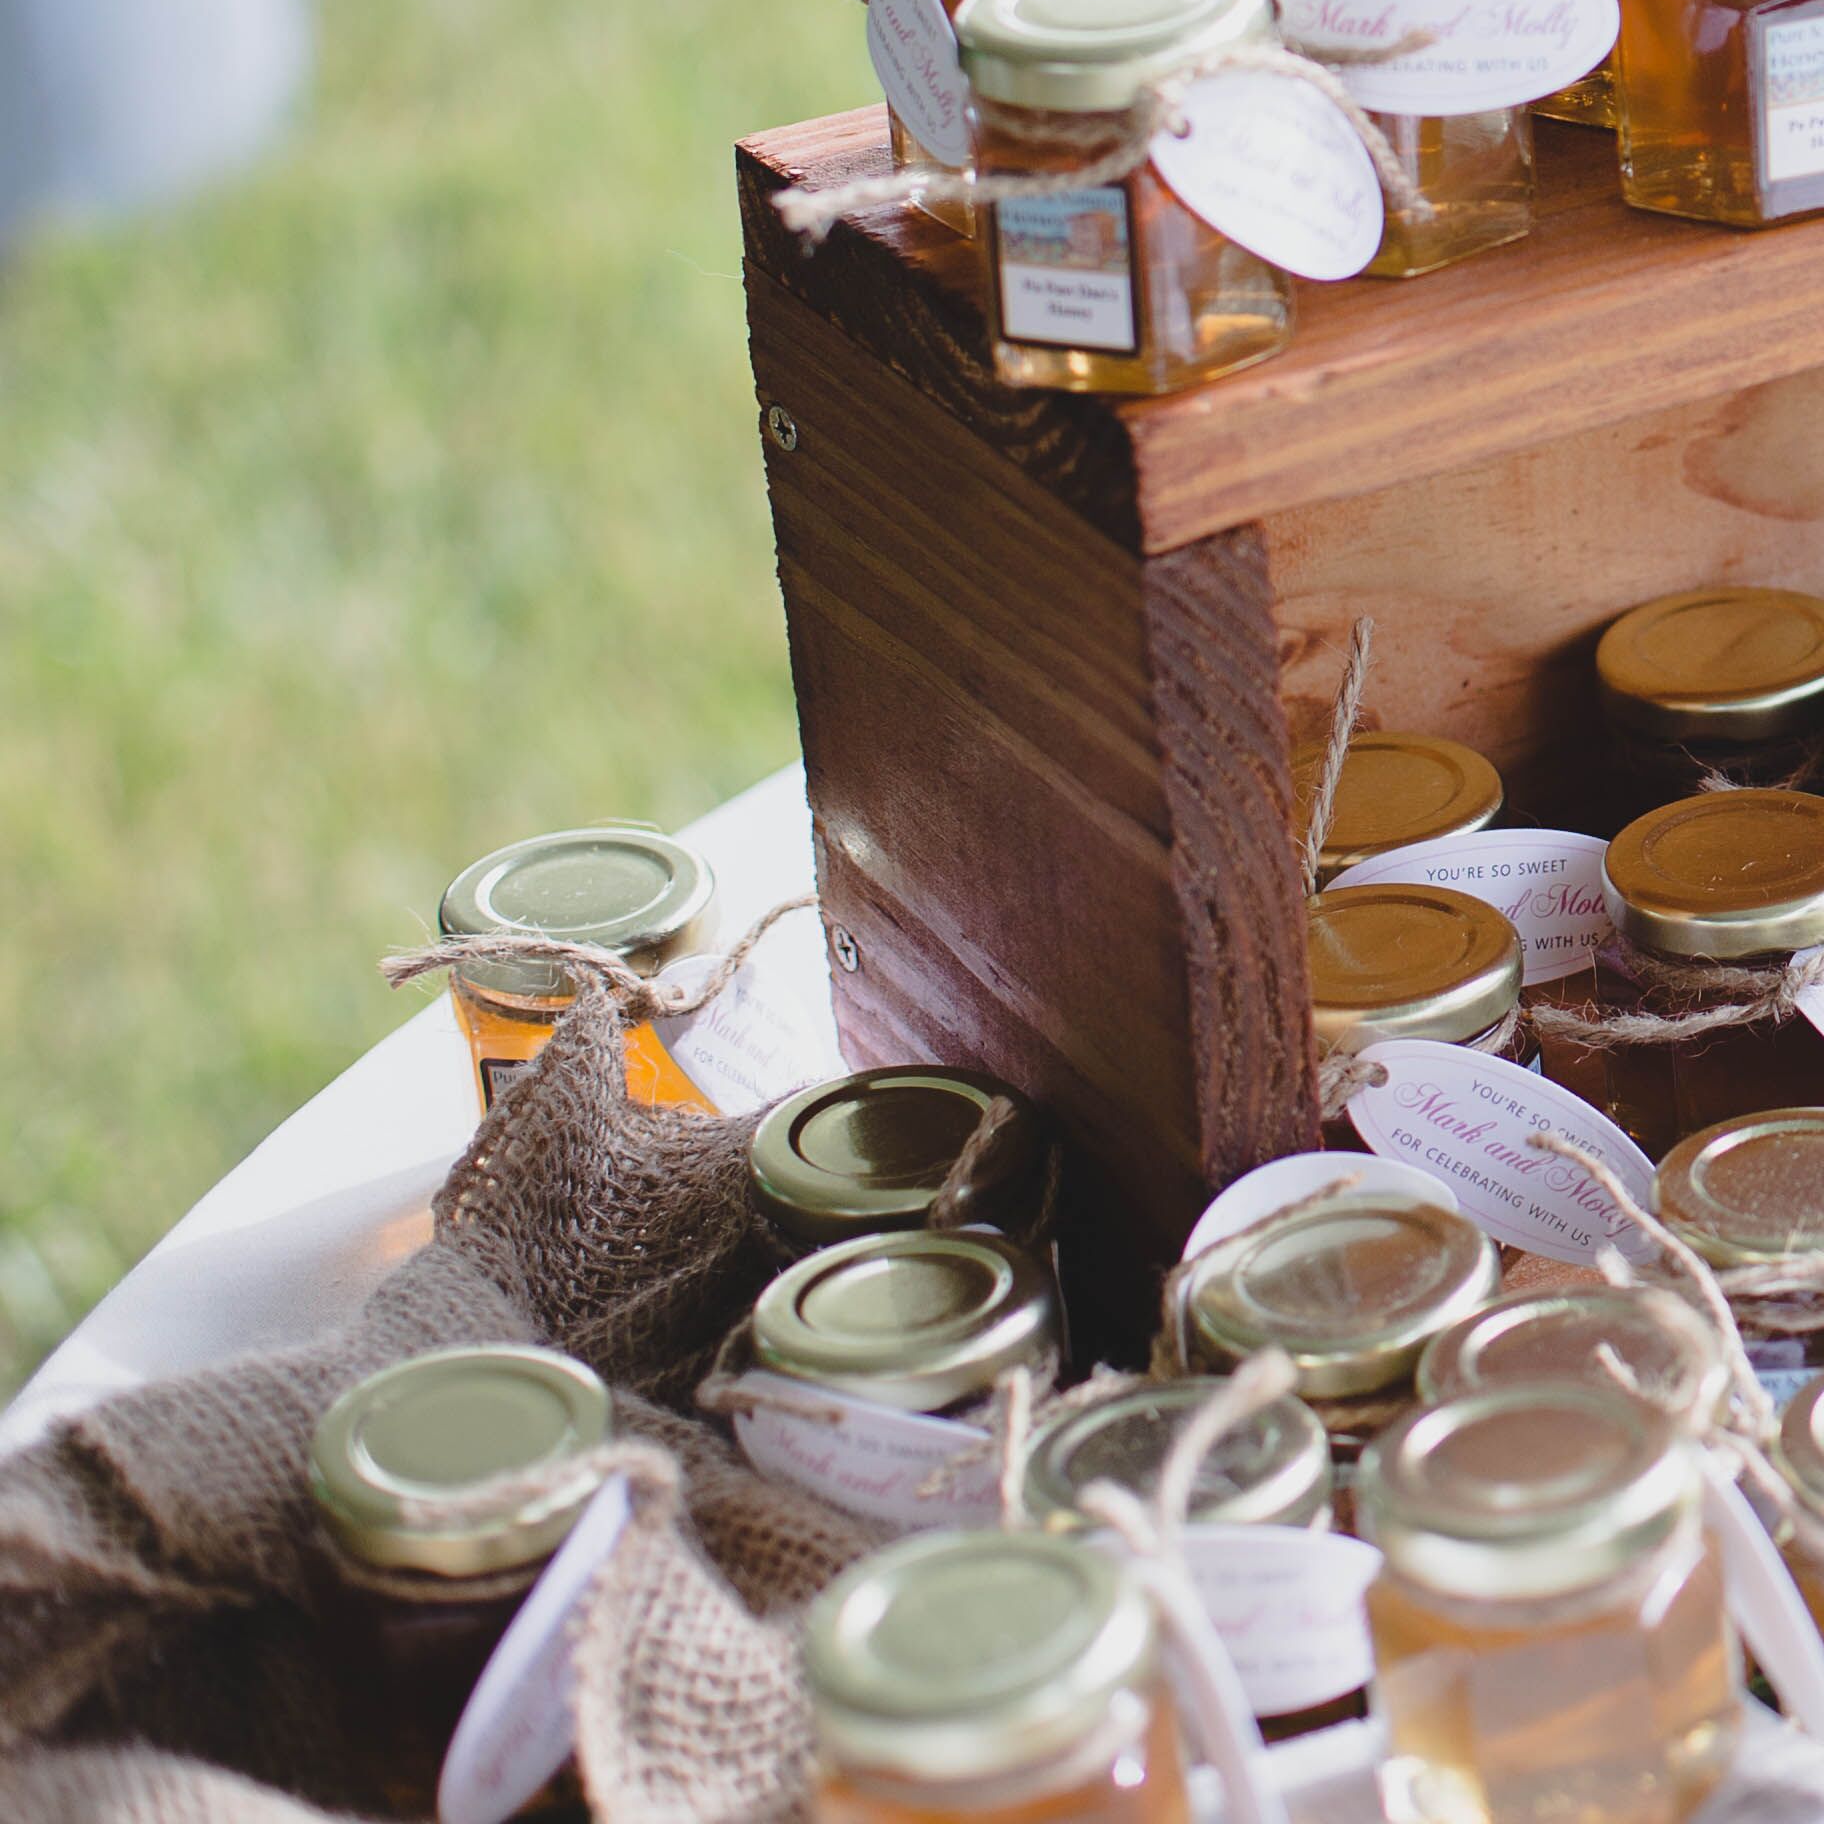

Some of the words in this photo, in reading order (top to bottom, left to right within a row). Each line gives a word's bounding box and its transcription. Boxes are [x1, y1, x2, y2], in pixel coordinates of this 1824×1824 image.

[1478, 0, 1580, 50] Molly
[1426, 866, 1484, 882] YOU'RE
[1491, 864, 1511, 878] SO
[1519, 858, 1568, 876] SWEET
[1536, 935, 1574, 951] WITH
[1580, 933, 1598, 946] US
[694, 1047, 713, 1063] FOR
[1394, 1081, 1498, 1147] Mark
[1483, 1140, 1552, 1177] and
[1471, 1079, 1526, 1119] YOU'RE
[1528, 1112, 1552, 1131] SO
[1391, 1128, 1420, 1153] FOR
[1426, 1147, 1525, 1209] CELEBRATING
[1528, 1202, 1568, 1233] WITH
[1571, 1227, 1592, 1247] US
